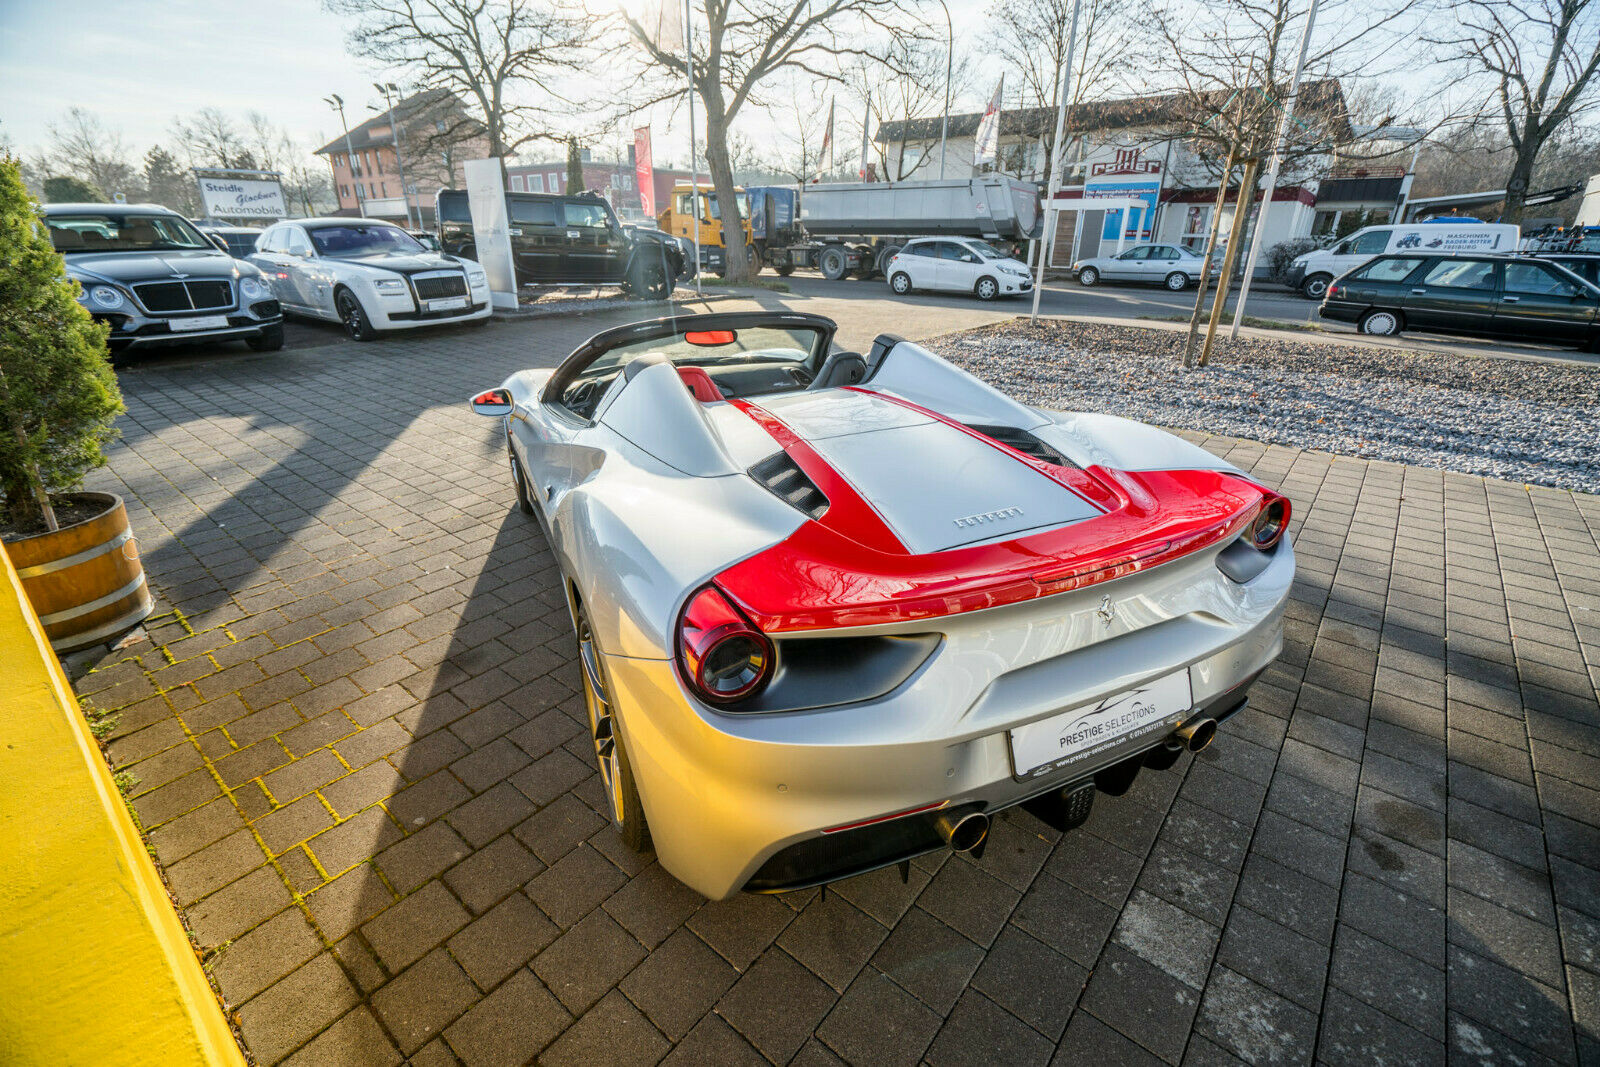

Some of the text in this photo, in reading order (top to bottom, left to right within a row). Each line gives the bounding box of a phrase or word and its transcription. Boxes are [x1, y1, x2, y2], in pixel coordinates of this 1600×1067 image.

[206, 184, 244, 192] Steidle
[213, 204, 282, 215] Automobile
[953, 506, 1024, 528] Ferrari
[1059, 723, 1104, 748] PRESTIGE
[1105, 704, 1156, 732] SELECTIONS
[1056, 737, 1127, 767] www.prestige-selections.com
